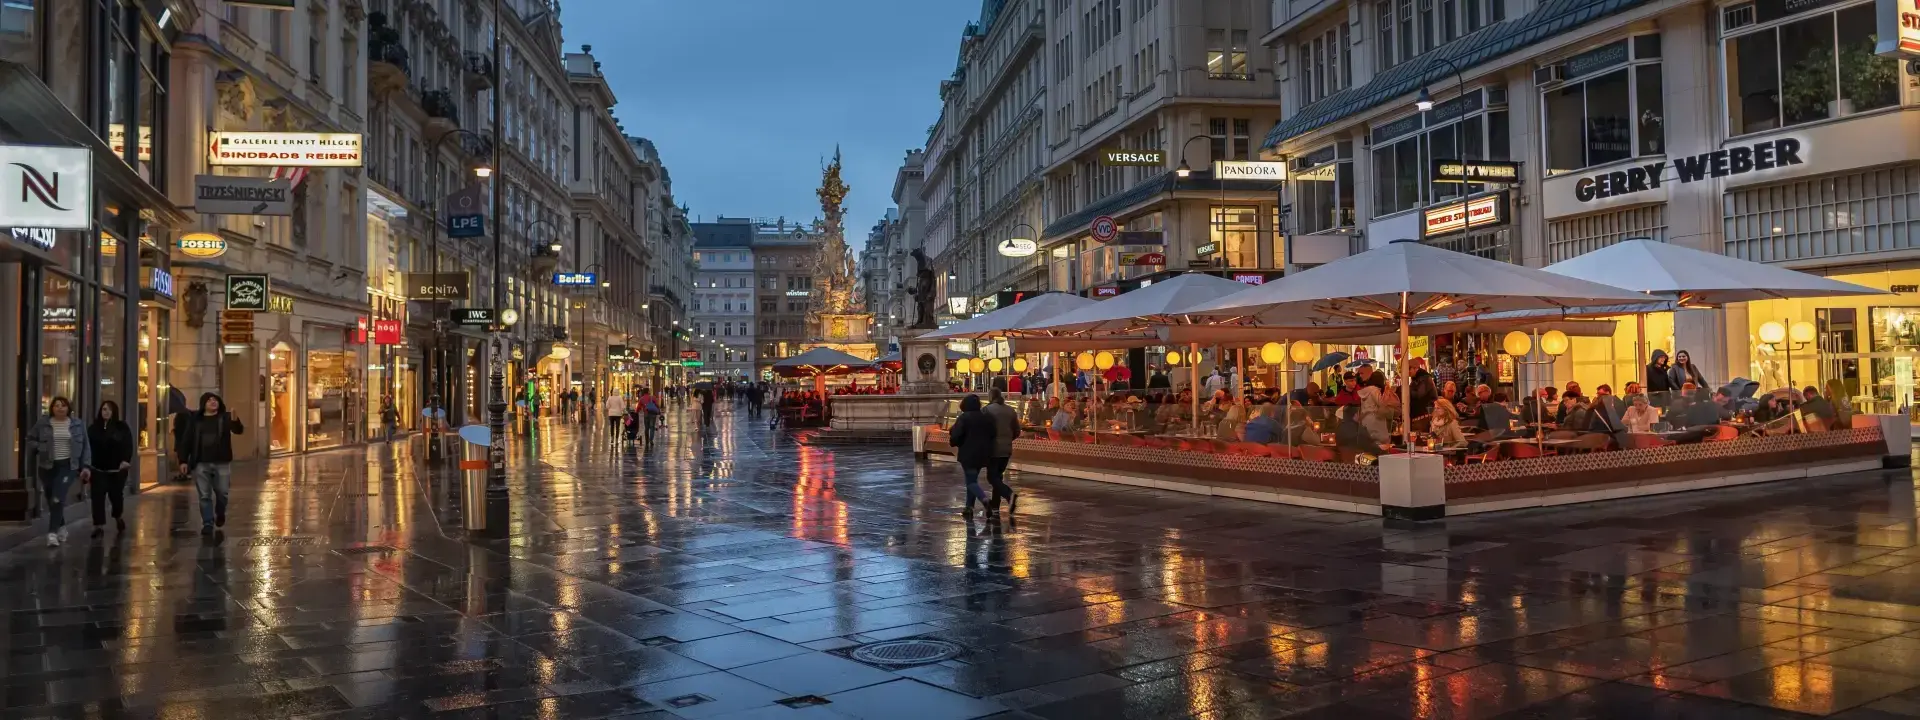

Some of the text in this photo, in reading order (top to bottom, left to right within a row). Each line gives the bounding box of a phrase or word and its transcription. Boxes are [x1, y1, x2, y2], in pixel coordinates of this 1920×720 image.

[1902, 12, 1920, 30] ST
[305, 152, 358, 160] REISEN
[1108, 153, 1160, 162] VERSACE
[1477, 166, 1515, 177] WEBER
[1575, 137, 1803, 202] GERRY WEBER
[452, 216, 478, 228] LPE
[154, 268, 173, 297] FOSSIL
[1890, 284, 1919, 293] GERRY
[468, 310, 487, 318] IWC
